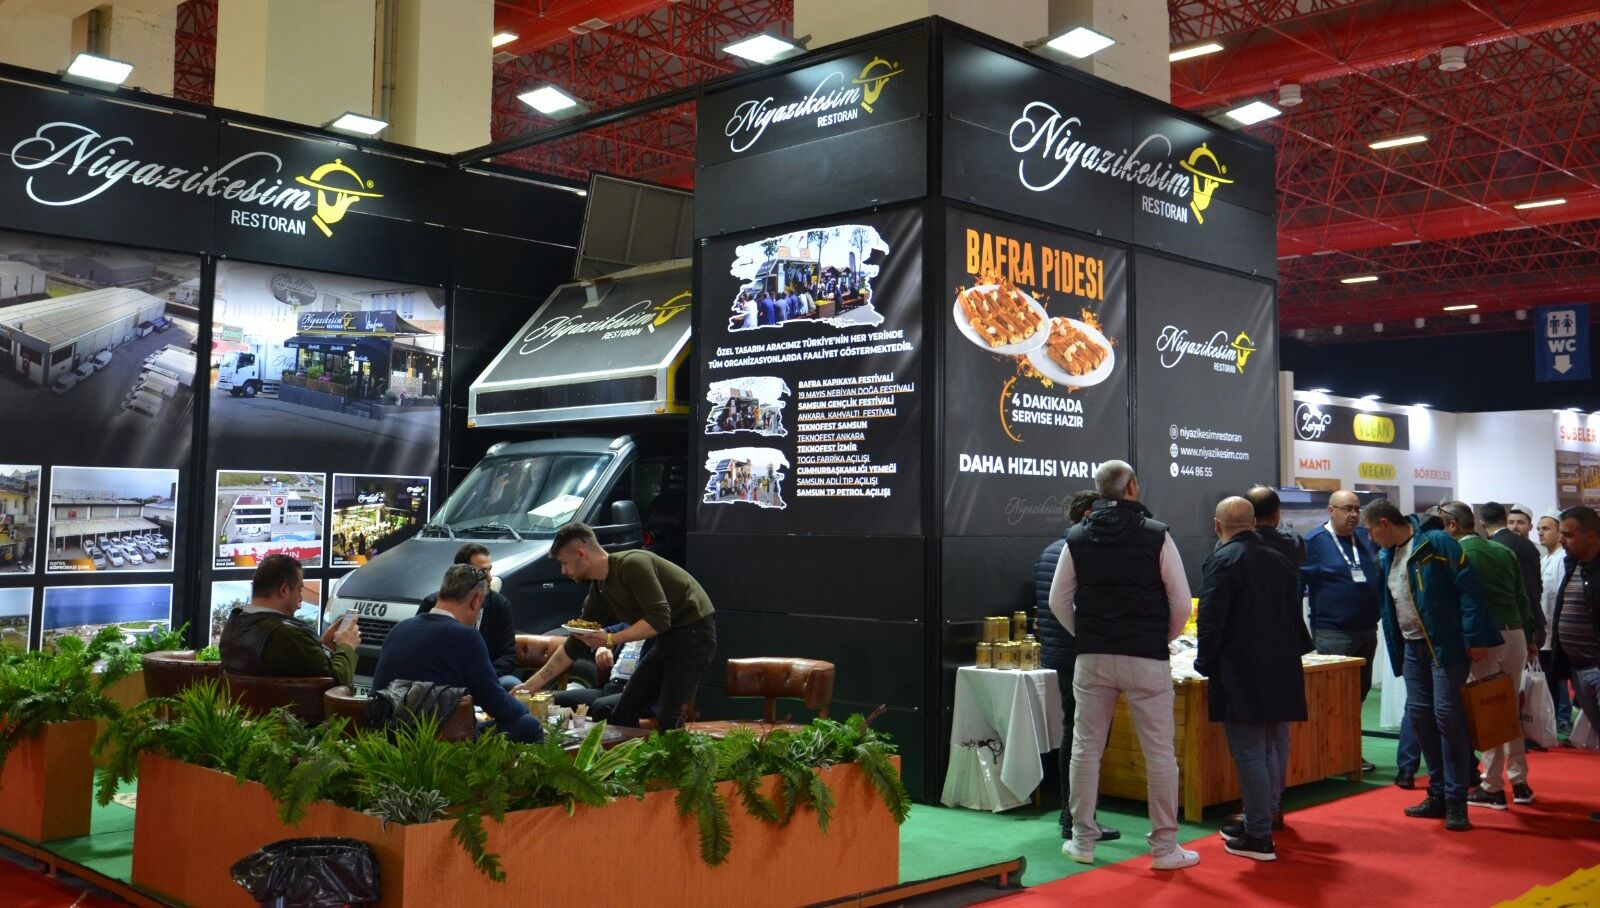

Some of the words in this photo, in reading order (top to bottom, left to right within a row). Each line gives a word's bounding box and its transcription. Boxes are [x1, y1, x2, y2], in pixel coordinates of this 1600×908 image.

[725, 71, 861, 153] Niyazikesim
[817, 109, 858, 128] RESTORAN
[1009, 101, 1191, 198] Niyazikesim
[11, 121, 312, 211] Niyazikesim
[1141, 195, 1188, 223] RESTORAN
[230, 209, 306, 236] RESTORAN
[966, 228, 1036, 287] BAFRA
[601, 328, 642, 341] RESTORAN
[716, 346, 734, 357] ÖZEL
[734, 344, 765, 355] TASARIM
[766, 340, 801, 352] ARACIMIZ
[803, 333, 849, 348] TÜRKİYE'NİN
[850, 334, 866, 343] HER
[868, 329, 904, 341] YERİNDE
[1156, 325, 1237, 369] Niyazikesim
[1547, 338, 1577, 353] WC
[708, 359, 723, 369] TÜM
[724, 353, 802, 368] ORGANİZASYONLARDA
[803, 348, 838, 361] FAALİYET
[798, 379, 821, 388] BAFRA
[822, 376, 857, 387] KAPIKAYA
[858, 371, 894, 384] FESTİVALİ
[798, 391, 805, 399] 19
[805, 389, 826, 399] MAYIS
[826, 387, 856, 397] NEBİYAN
[857, 385, 879, 395] DOĞA
[879, 381, 915, 393] FESTİVALİ
[798, 401, 827, 410] SAMSUN
[827, 396, 858, 409] GENÇLİK
[858, 394, 895, 406] FESTİVALİ
[1011, 392, 1021, 407] 4
[1023, 393, 1083, 414] DAKİKADA
[798, 411, 825, 421] ANKARA
[827, 409, 860, 419] KAHVALTI
[1011, 409, 1053, 425] SERVİSE
[1054, 414, 1083, 428] HAZIR
[797, 422, 836, 431] TEKNOFEST
[837, 420, 868, 430] SAMSUN
[797, 433, 835, 442] TEKNOFEST
[836, 432, 865, 441] ANKARA
[1180, 427, 1242, 443] niyazikesimrestoran
[797, 444, 836, 453] TEKNOFEST
[837, 441, 858, 452] İZMİR
[1180, 446, 1250, 461] www.niyazikesim.com
[797, 455, 815, 464] TOGG
[816, 453, 845, 463] FABRİKA
[846, 453, 871, 464] AÇILIŞI
[959, 453, 1005, 474] DAHA
[1008, 457, 1057, 477] HIZLISI
[1060, 460, 1088, 479] VAR
[1091, 462, 1103, 479] M
[1299, 458, 1331, 471] MANTI
[796, 464, 868, 476] CUMHURBAŞKANLIĞI
[1180, 465, 1195, 476] 444
[1195, 466, 1204, 477] 86
[1204, 467, 1213, 477] 55
[1361, 462, 1392, 478] VEGAN
[797, 477, 825, 486] SAMSUN
[825, 475, 842, 486] ADLİ
[842, 477, 854, 485] TIP
[854, 476, 878, 487] AÇILIŞI
[796, 488, 825, 497] SAMSUN
[826, 488, 836, 496] TP
[837, 488, 864, 496] PETROL
[865, 487, 891, 498] AÇILIŞI
[353, 601, 388, 617] IVECO
